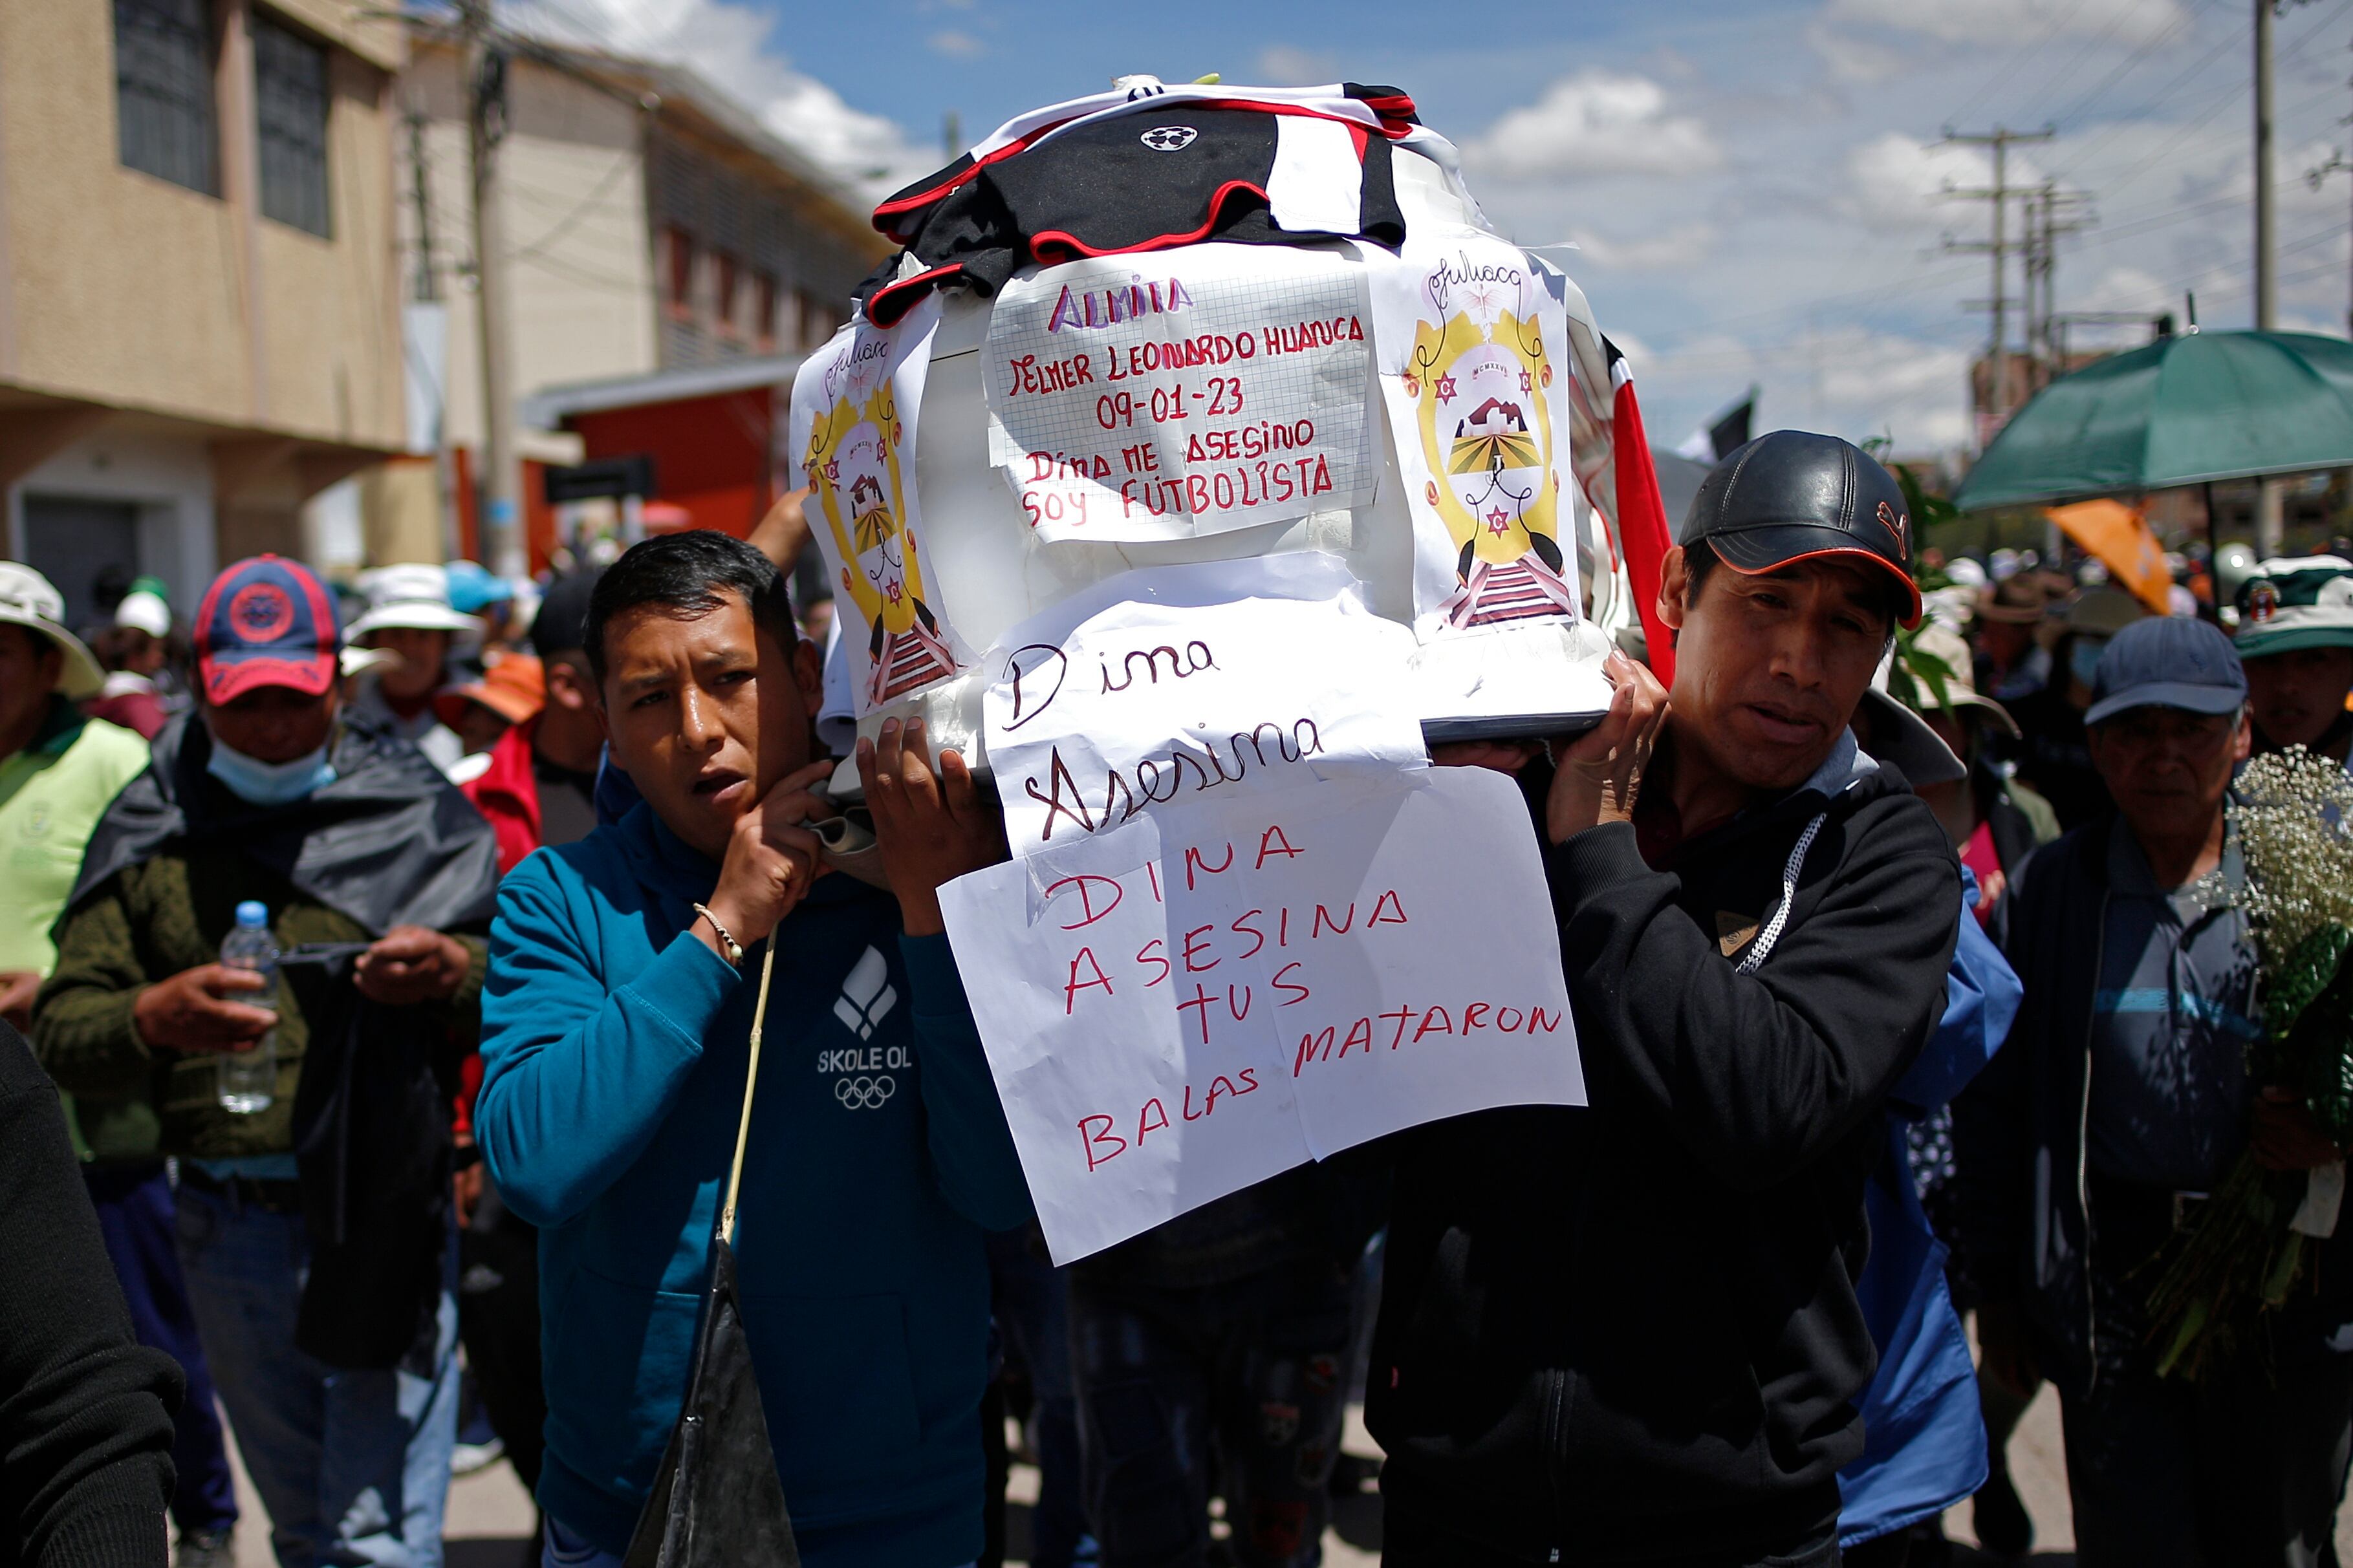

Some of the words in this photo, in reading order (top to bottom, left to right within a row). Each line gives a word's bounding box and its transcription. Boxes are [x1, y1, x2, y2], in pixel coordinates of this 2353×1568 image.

[1107, 331, 1255, 381] LEONARDO
[1263, 315, 1364, 356] HUANCA
[1096, 377, 1244, 429] 09-01-23
[1122, 442, 1158, 473] ME
[1022, 491, 1087, 527] SOY
[1002, 640, 1220, 731] Dina
[1025, 718, 1324, 841] Asesina
[1045, 825, 1305, 930] DINA
[1065, 890, 1407, 1015] ASESINA
[1176, 962, 1310, 1044] TUS
[818, 1047, 882, 1073] SKOLE
[887, 1046, 912, 1068] OL
[1078, 1068, 1259, 1172] BALAS
[1294, 1002, 1561, 1077] MATARON
